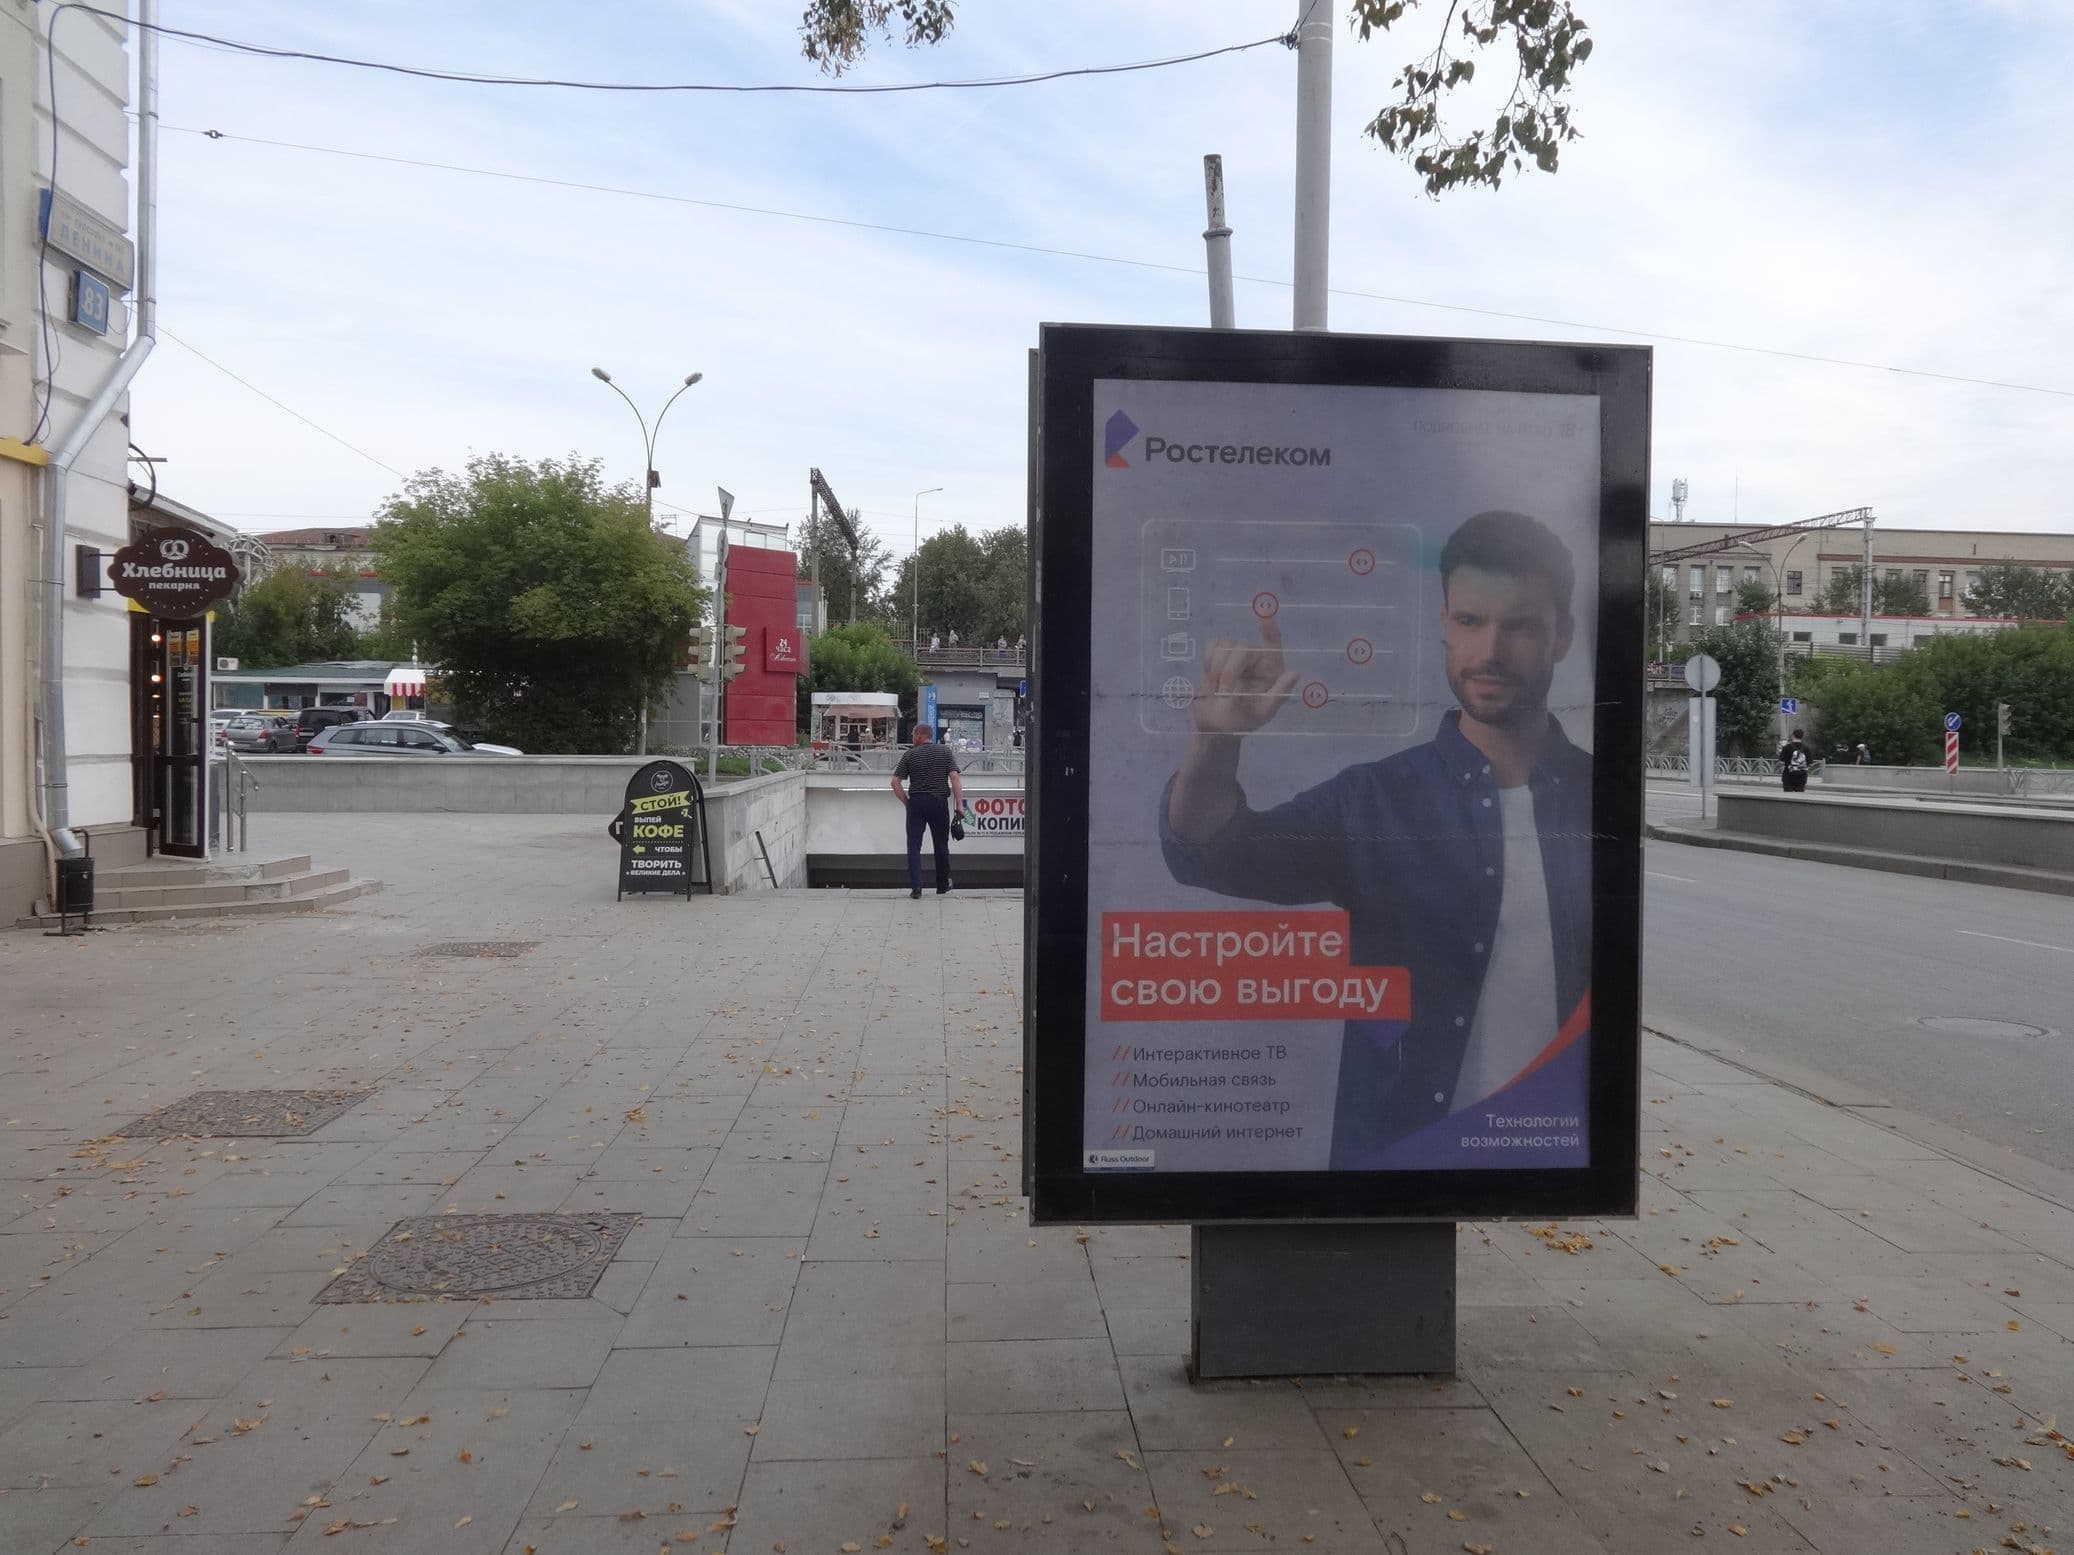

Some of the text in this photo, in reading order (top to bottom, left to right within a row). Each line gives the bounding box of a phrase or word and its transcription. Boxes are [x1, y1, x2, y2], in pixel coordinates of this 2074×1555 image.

[60, 223, 124, 273] ЛЕНИНА
[83, 288, 104, 321] 83
[1145, 437, 1332, 467] Ростелеком
[122, 562, 227, 582] Хлебница
[149, 582, 200, 591] пекарня
[640, 794, 682, 812] СТОЙ!
[634, 815, 662, 824] ВЫПЕЙ
[977, 817, 1025, 830] КОПИ
[633, 824, 684, 838] КОФЕ
[631, 860, 682, 869] ТВОРИТЬ
[661, 869, 681, 877] ДЕЛА
[1111, 922, 1343, 966] Настройте
[1111, 976, 1388, 1013] свою выгоду
[1133, 1045, 1287, 1063] Интерактивное ТВ
[1132, 1072, 1277, 1088] Мобильная связь
[1132, 1098, 1291, 1115] Онлайн-кинотеатр
[1486, 1114, 1579, 1128] Технологии
[1132, 1124, 1304, 1142] Домашний интернет
[1461, 1134, 1579, 1148] возможностей
[1100, 1155, 1150, 1163] Russ Outdoor
